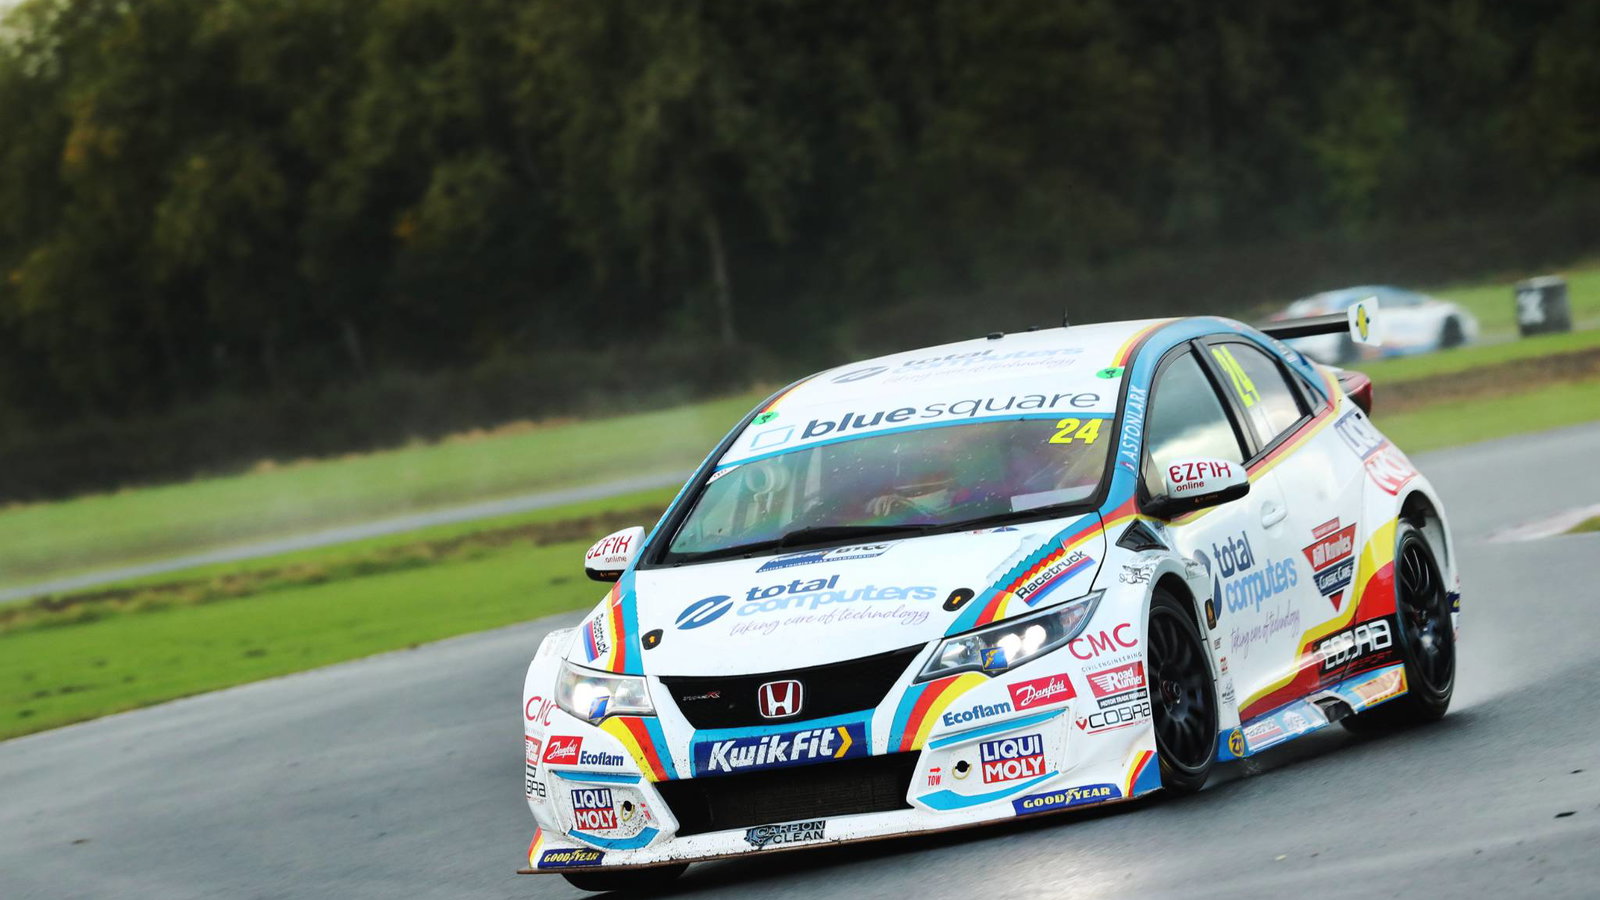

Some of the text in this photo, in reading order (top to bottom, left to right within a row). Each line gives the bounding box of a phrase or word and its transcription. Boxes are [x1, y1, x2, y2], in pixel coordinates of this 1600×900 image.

[1048, 418, 1103, 444] 24
[1212, 530, 1256, 579] total
[745, 574, 840, 602] total
[1015, 549, 1088, 600] Racetruck
[1225, 556, 1298, 614] computers
[736, 584, 938, 617] computers
[729, 604, 930, 637] taking care of technology
[1068, 623, 1139, 660] CMC
[1016, 680, 1068, 706] Danfoss
[943, 699, 1011, 727] Ecoflam
[580, 751, 624, 767] Ecoflam
[982, 734, 1041, 762] LIQUI
[928, 775, 942, 787] TOW
[984, 757, 1045, 782] MOLY
[573, 789, 612, 808] LIQUI
[576, 810, 616, 829] MOLY
[757, 820, 826, 836] CARBON
[773, 830, 824, 844] CLEAN
